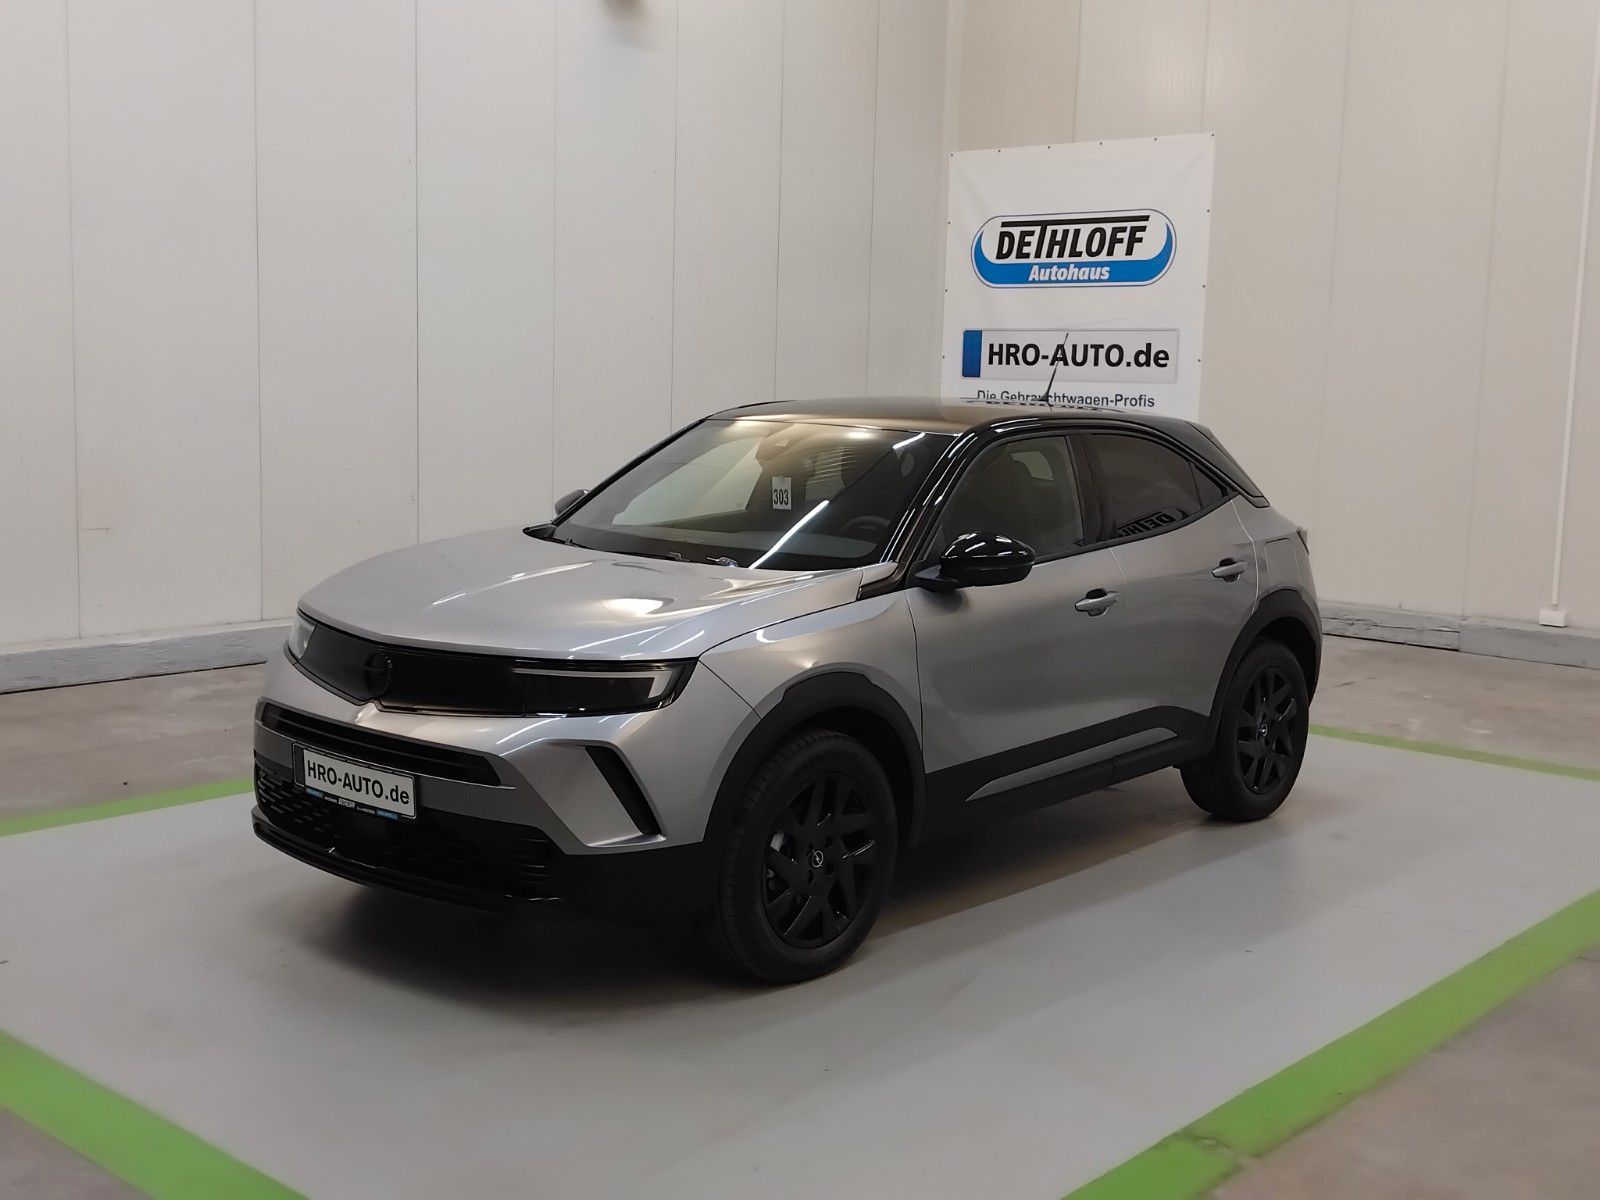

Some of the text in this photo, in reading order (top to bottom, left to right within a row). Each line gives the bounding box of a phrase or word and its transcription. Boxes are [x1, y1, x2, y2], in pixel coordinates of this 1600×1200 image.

[995, 215, 1150, 260] DETHLOFF
[1028, 264, 1110, 281] Autohaus
[988, 342, 1170, 368] HRO-AUTO.de
[978, 390, 1155, 408] Die Gebrachtwagen-Profis
[773, 488, 789, 506] 303
[307, 759, 410, 805] HRO-AUTO.de
